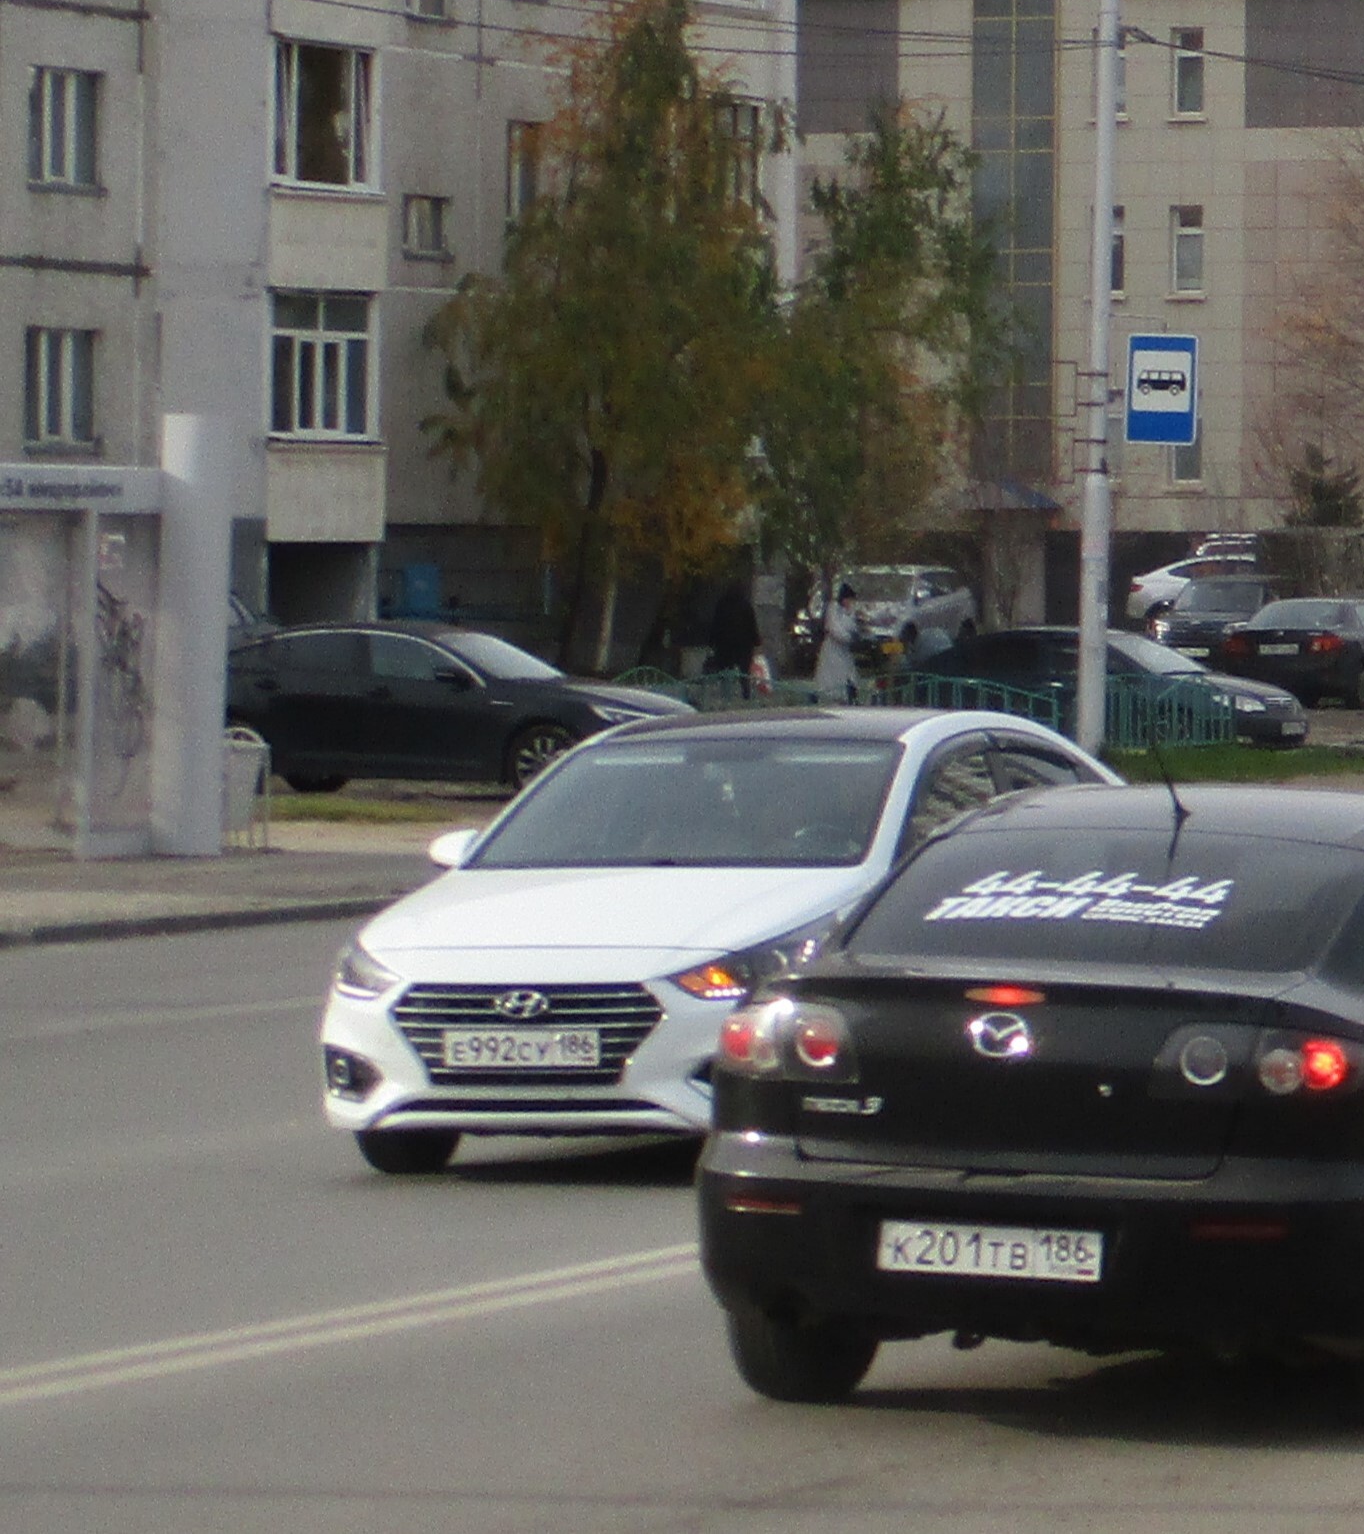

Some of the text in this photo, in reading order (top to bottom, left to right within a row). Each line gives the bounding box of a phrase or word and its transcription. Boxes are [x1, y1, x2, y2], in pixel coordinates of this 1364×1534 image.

[962, 870, 1235, 905] 44-44-44
[923, 896, 1093, 922] ТАКСИ
[891, 1228, 1092, 1271] К201ТВ 186
